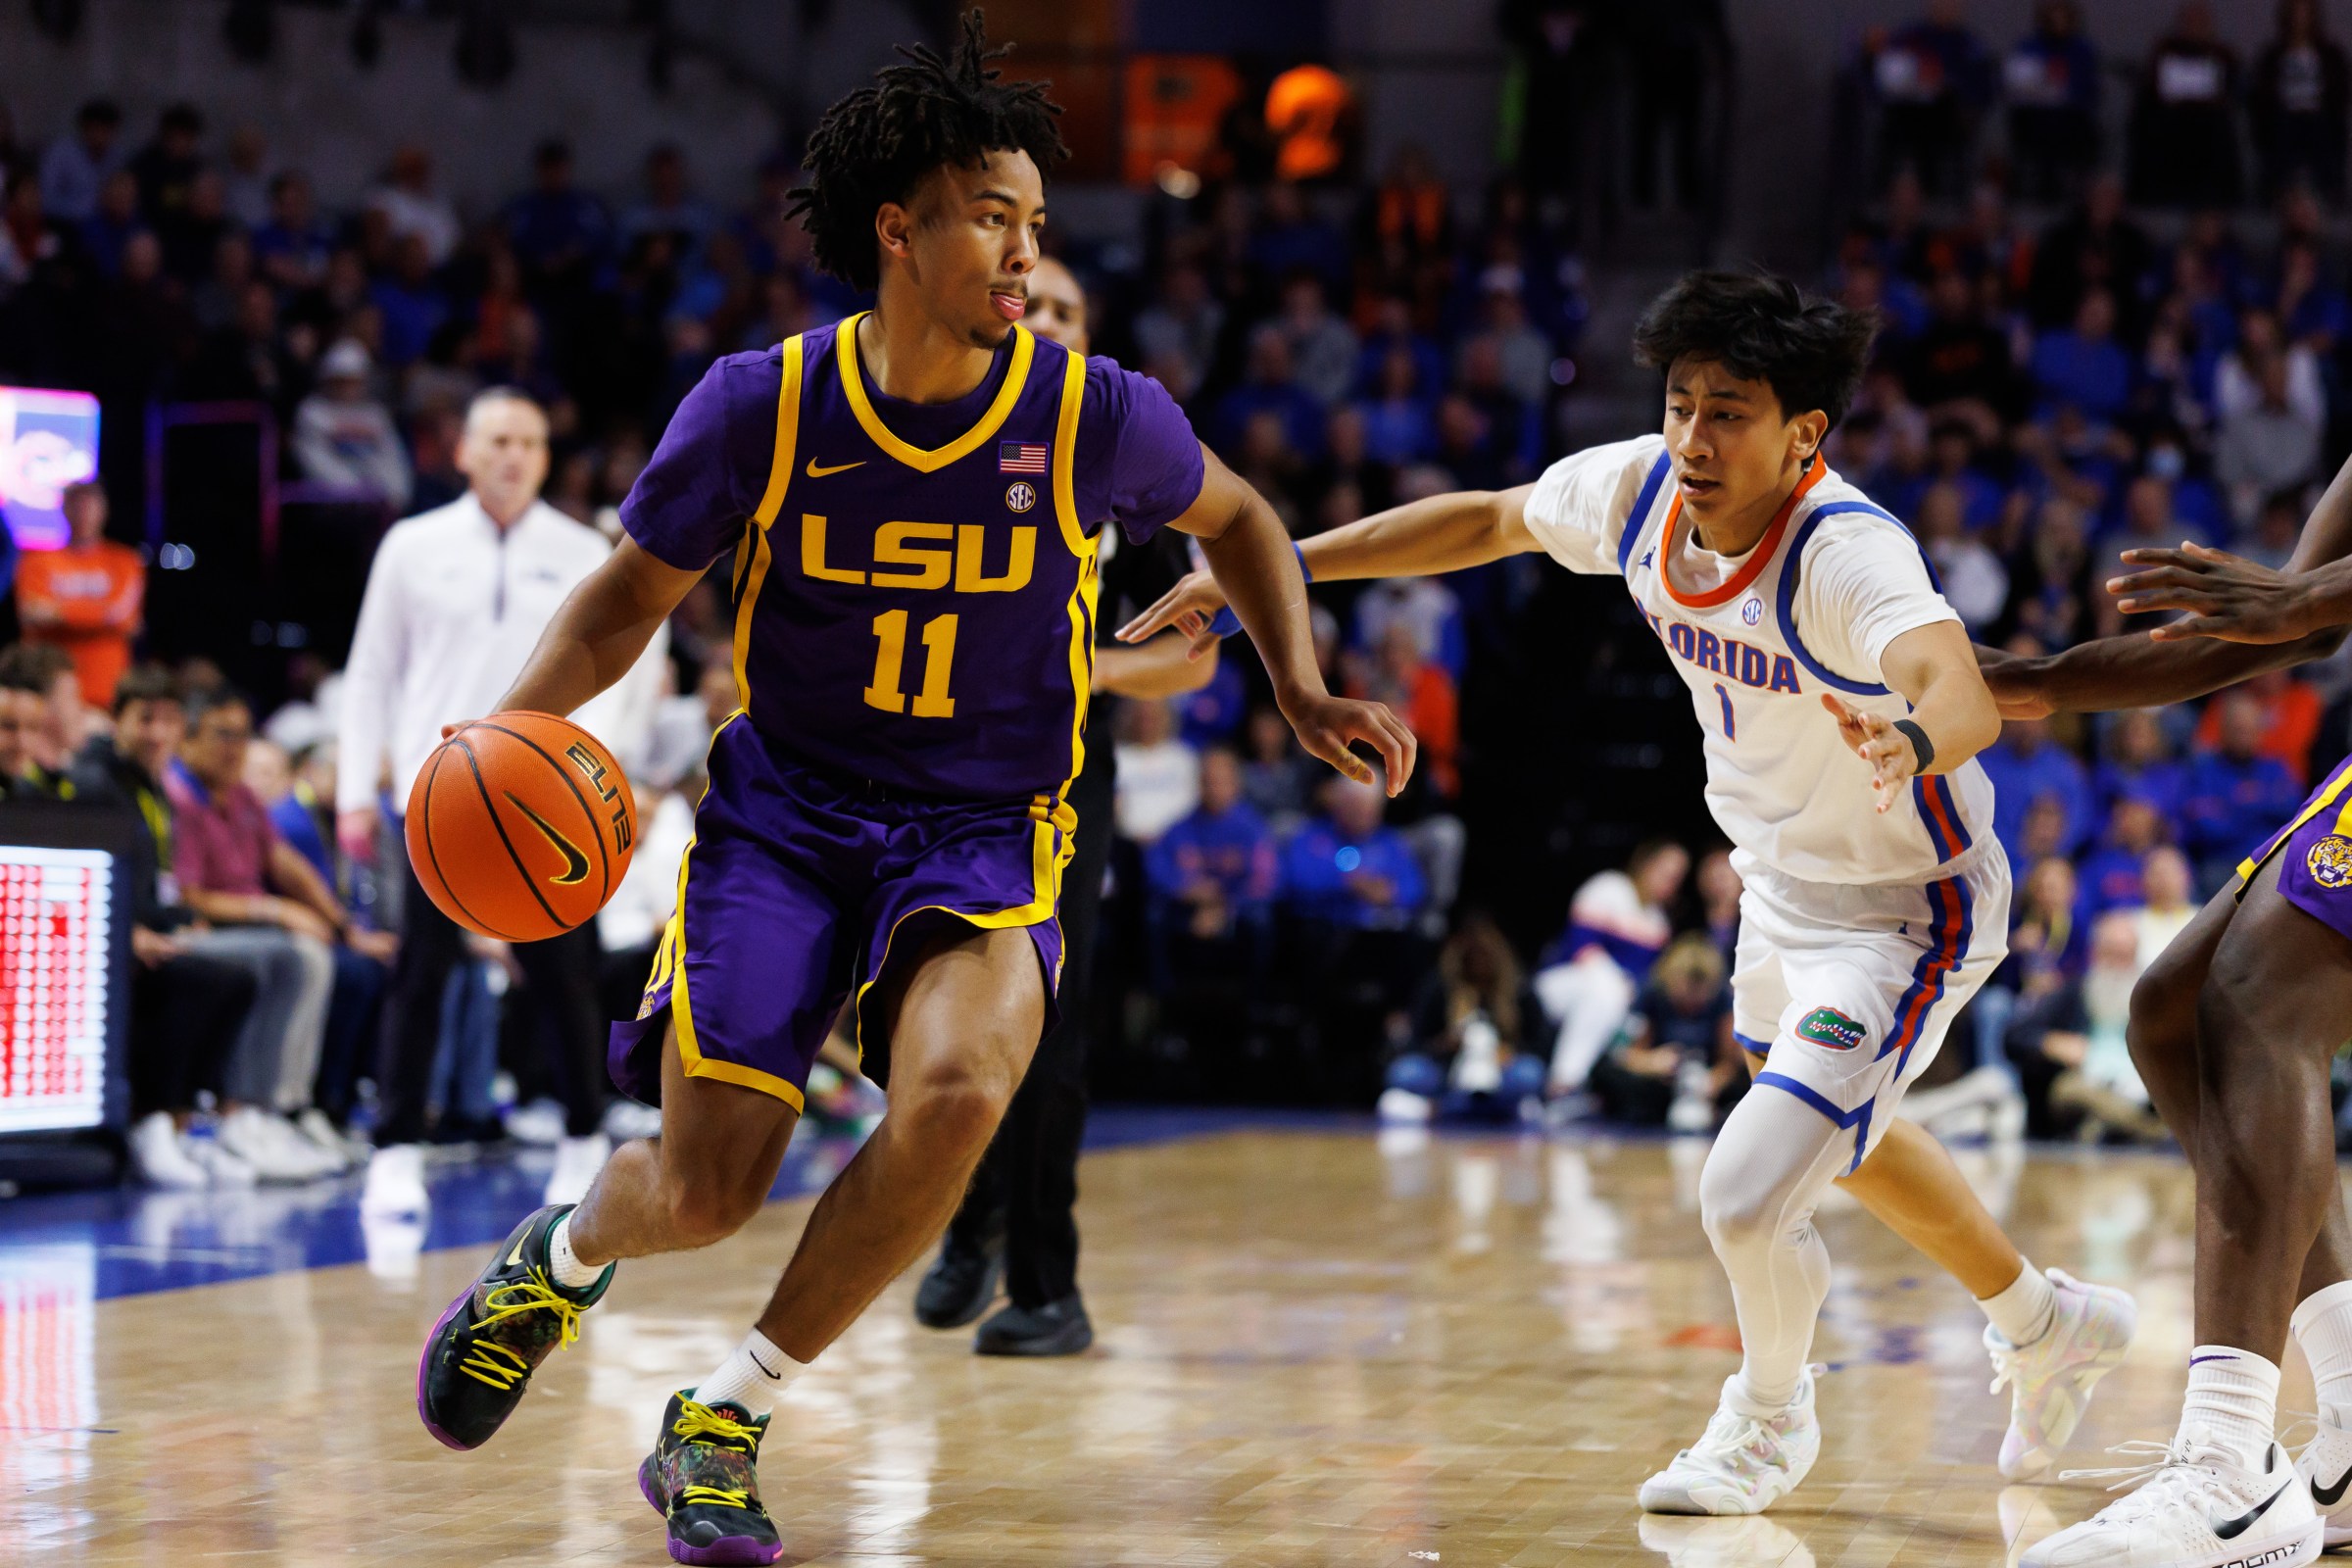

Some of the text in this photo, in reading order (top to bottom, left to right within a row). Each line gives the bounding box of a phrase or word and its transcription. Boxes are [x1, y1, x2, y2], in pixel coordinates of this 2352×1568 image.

[1009, 485, 1032, 510] SEC
[802, 513, 1037, 593] LSU
[863, 609, 958, 718] 11
[1634, 595, 1801, 695] ORIDA
[1713, 682, 1736, 743] 1
[565, 740, 632, 857] ELITE
